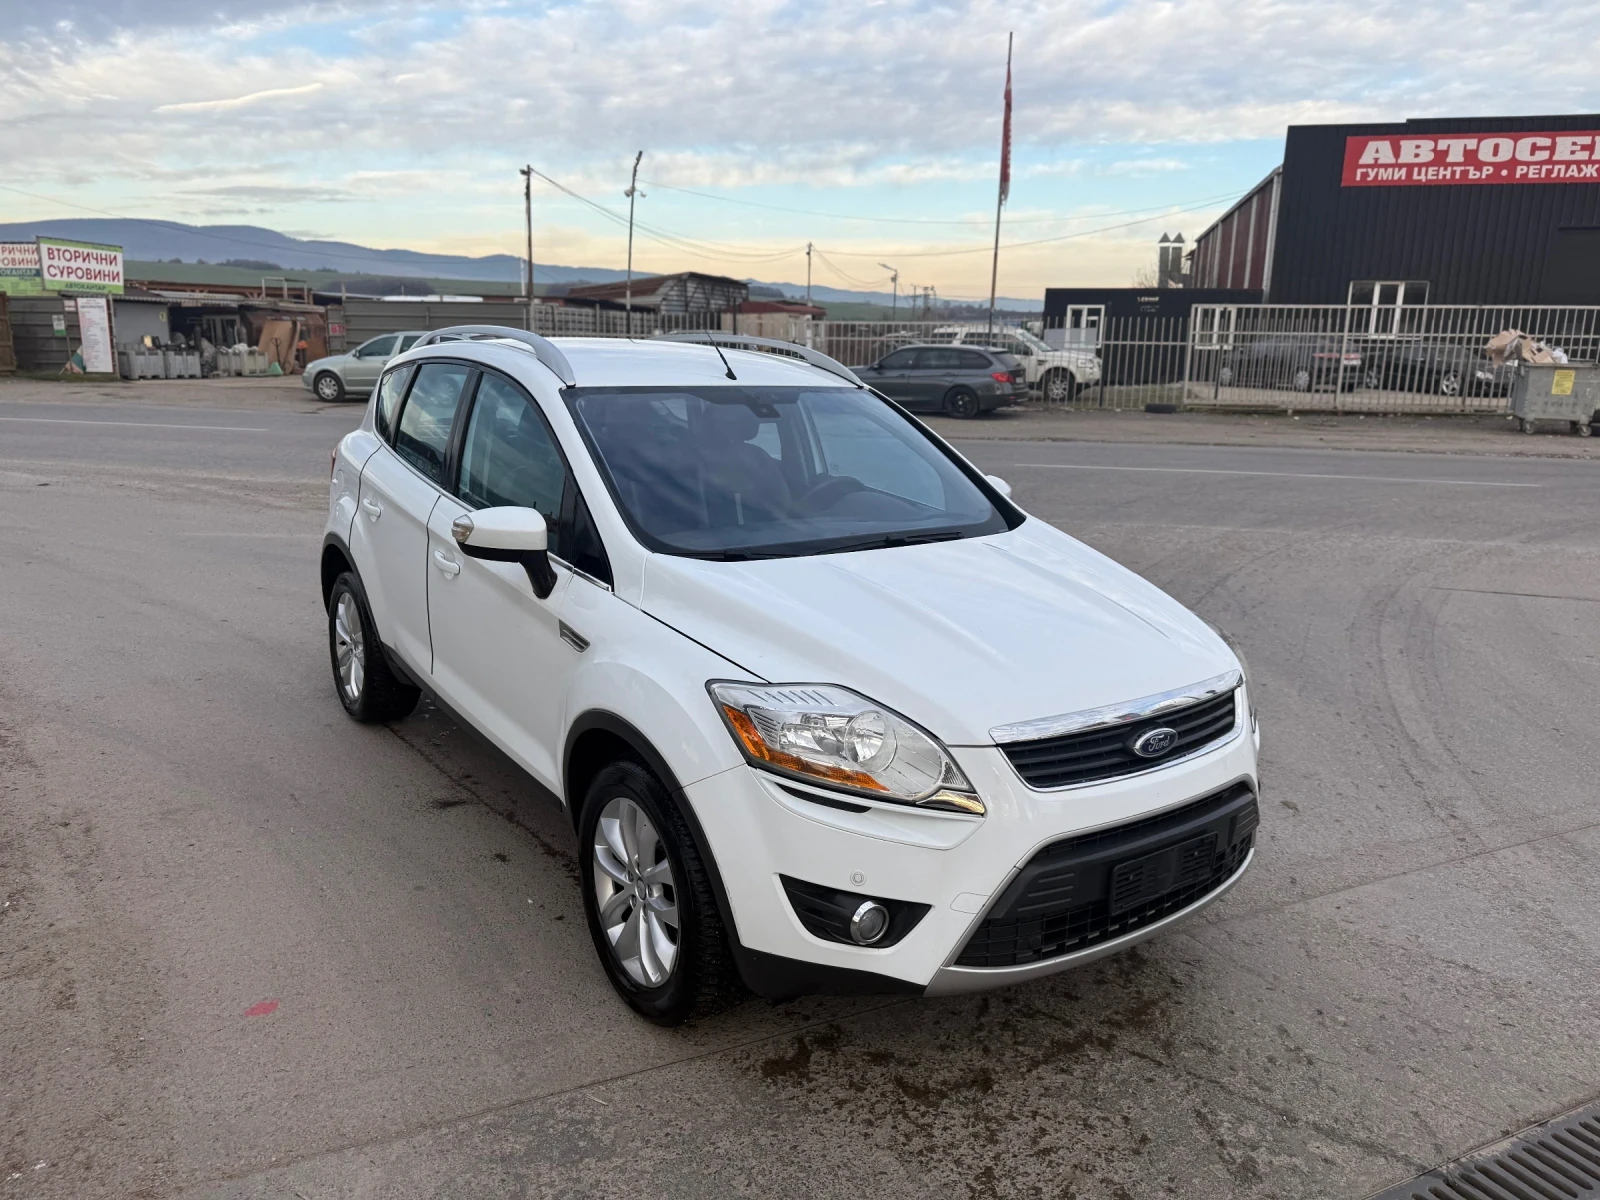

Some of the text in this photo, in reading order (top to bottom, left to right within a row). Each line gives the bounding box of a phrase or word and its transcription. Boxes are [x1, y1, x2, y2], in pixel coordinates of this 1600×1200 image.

[1358, 135, 1600, 165] АВТОСЕ
[1355, 163, 1600, 182] ГУМИ ЦЕНТЪР РЕГЛАЖ
[0, 257, 40, 267] ОВИНИ
[47, 247, 118, 267] ВТОРИЧНИ
[47, 264, 120, 283] СУРОВИНИ
[65, 283, 106, 291] АВТОКАНТАР
[1148, 734, 1170, 752] Ford
